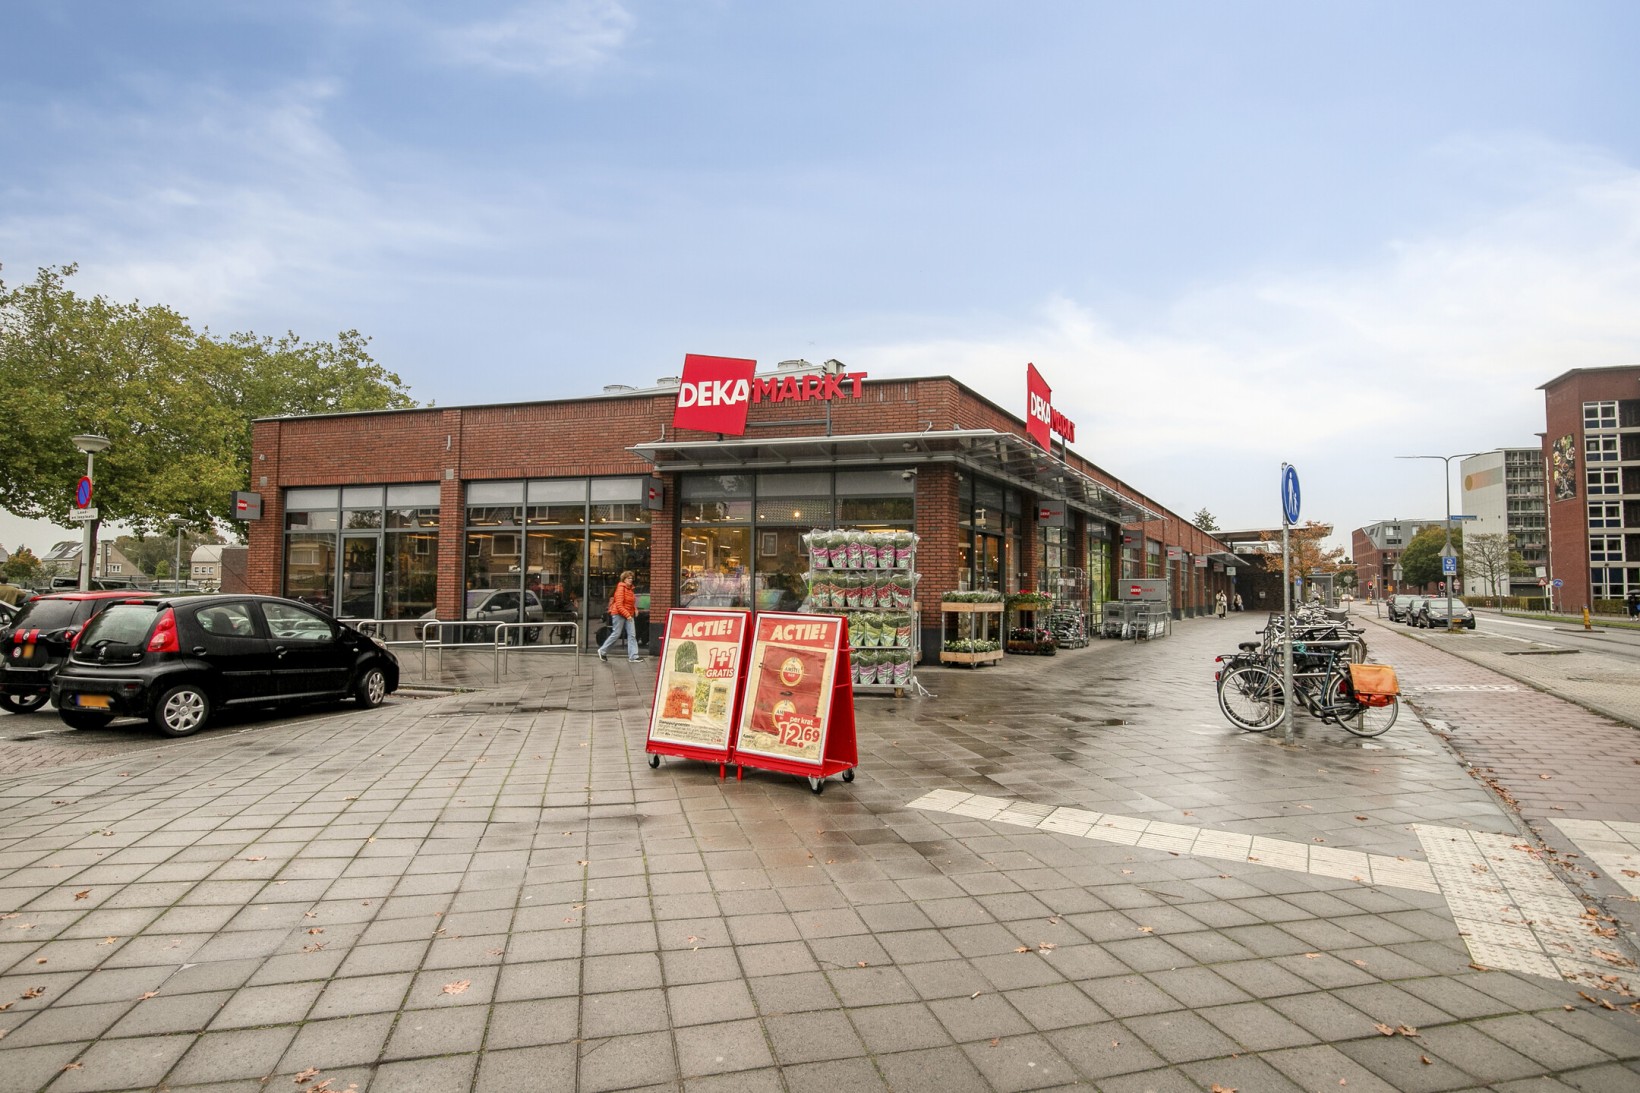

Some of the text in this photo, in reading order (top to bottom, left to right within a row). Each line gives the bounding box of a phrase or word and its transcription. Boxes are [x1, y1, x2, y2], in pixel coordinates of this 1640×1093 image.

[681, 619, 734, 638] ACTIE!
[769, 623, 828, 641] ACTIE!
[708, 646, 738, 670] 1+1
[705, 669, 735, 678] GRATIS
[790, 716, 800, 724] per
[801, 717, 814, 726] krat
[779, 723, 820, 748] 12.69
